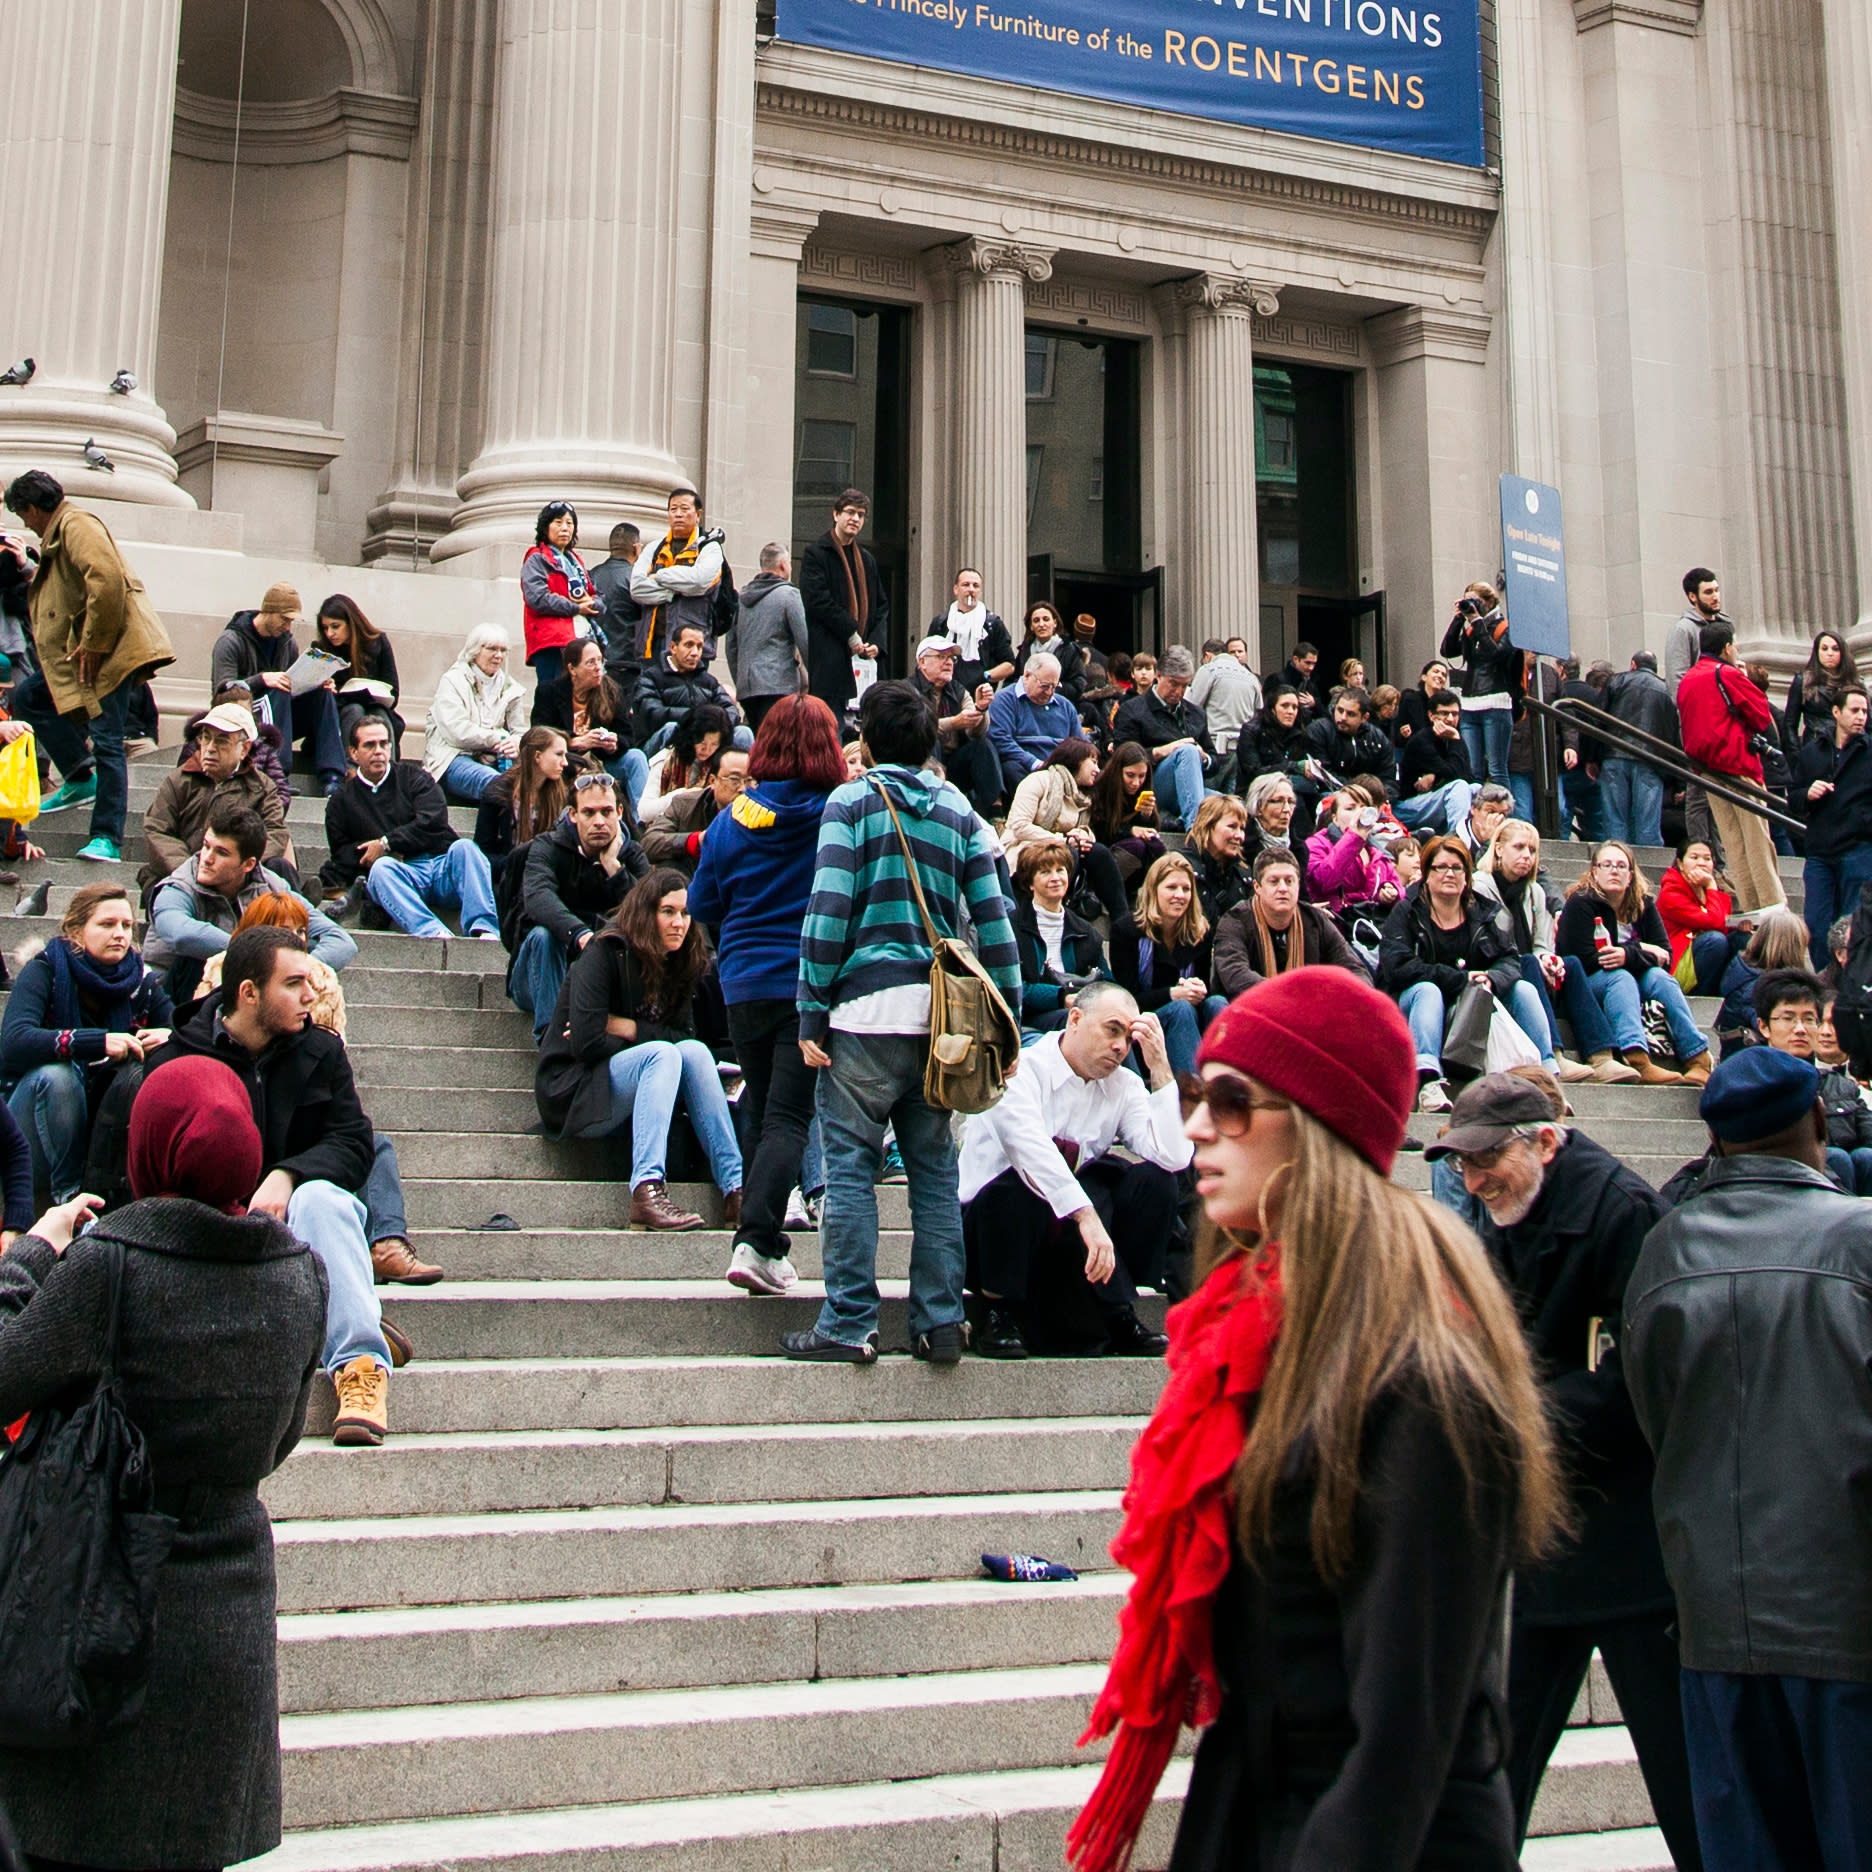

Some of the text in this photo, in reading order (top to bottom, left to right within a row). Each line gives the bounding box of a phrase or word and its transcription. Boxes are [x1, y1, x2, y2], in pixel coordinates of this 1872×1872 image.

[975, 4, 1080, 46] Furniture
[1086, 27, 1111, 51] of
[1115, 32, 1154, 60] the
[1165, 29, 1426, 110] ROENTGENS
